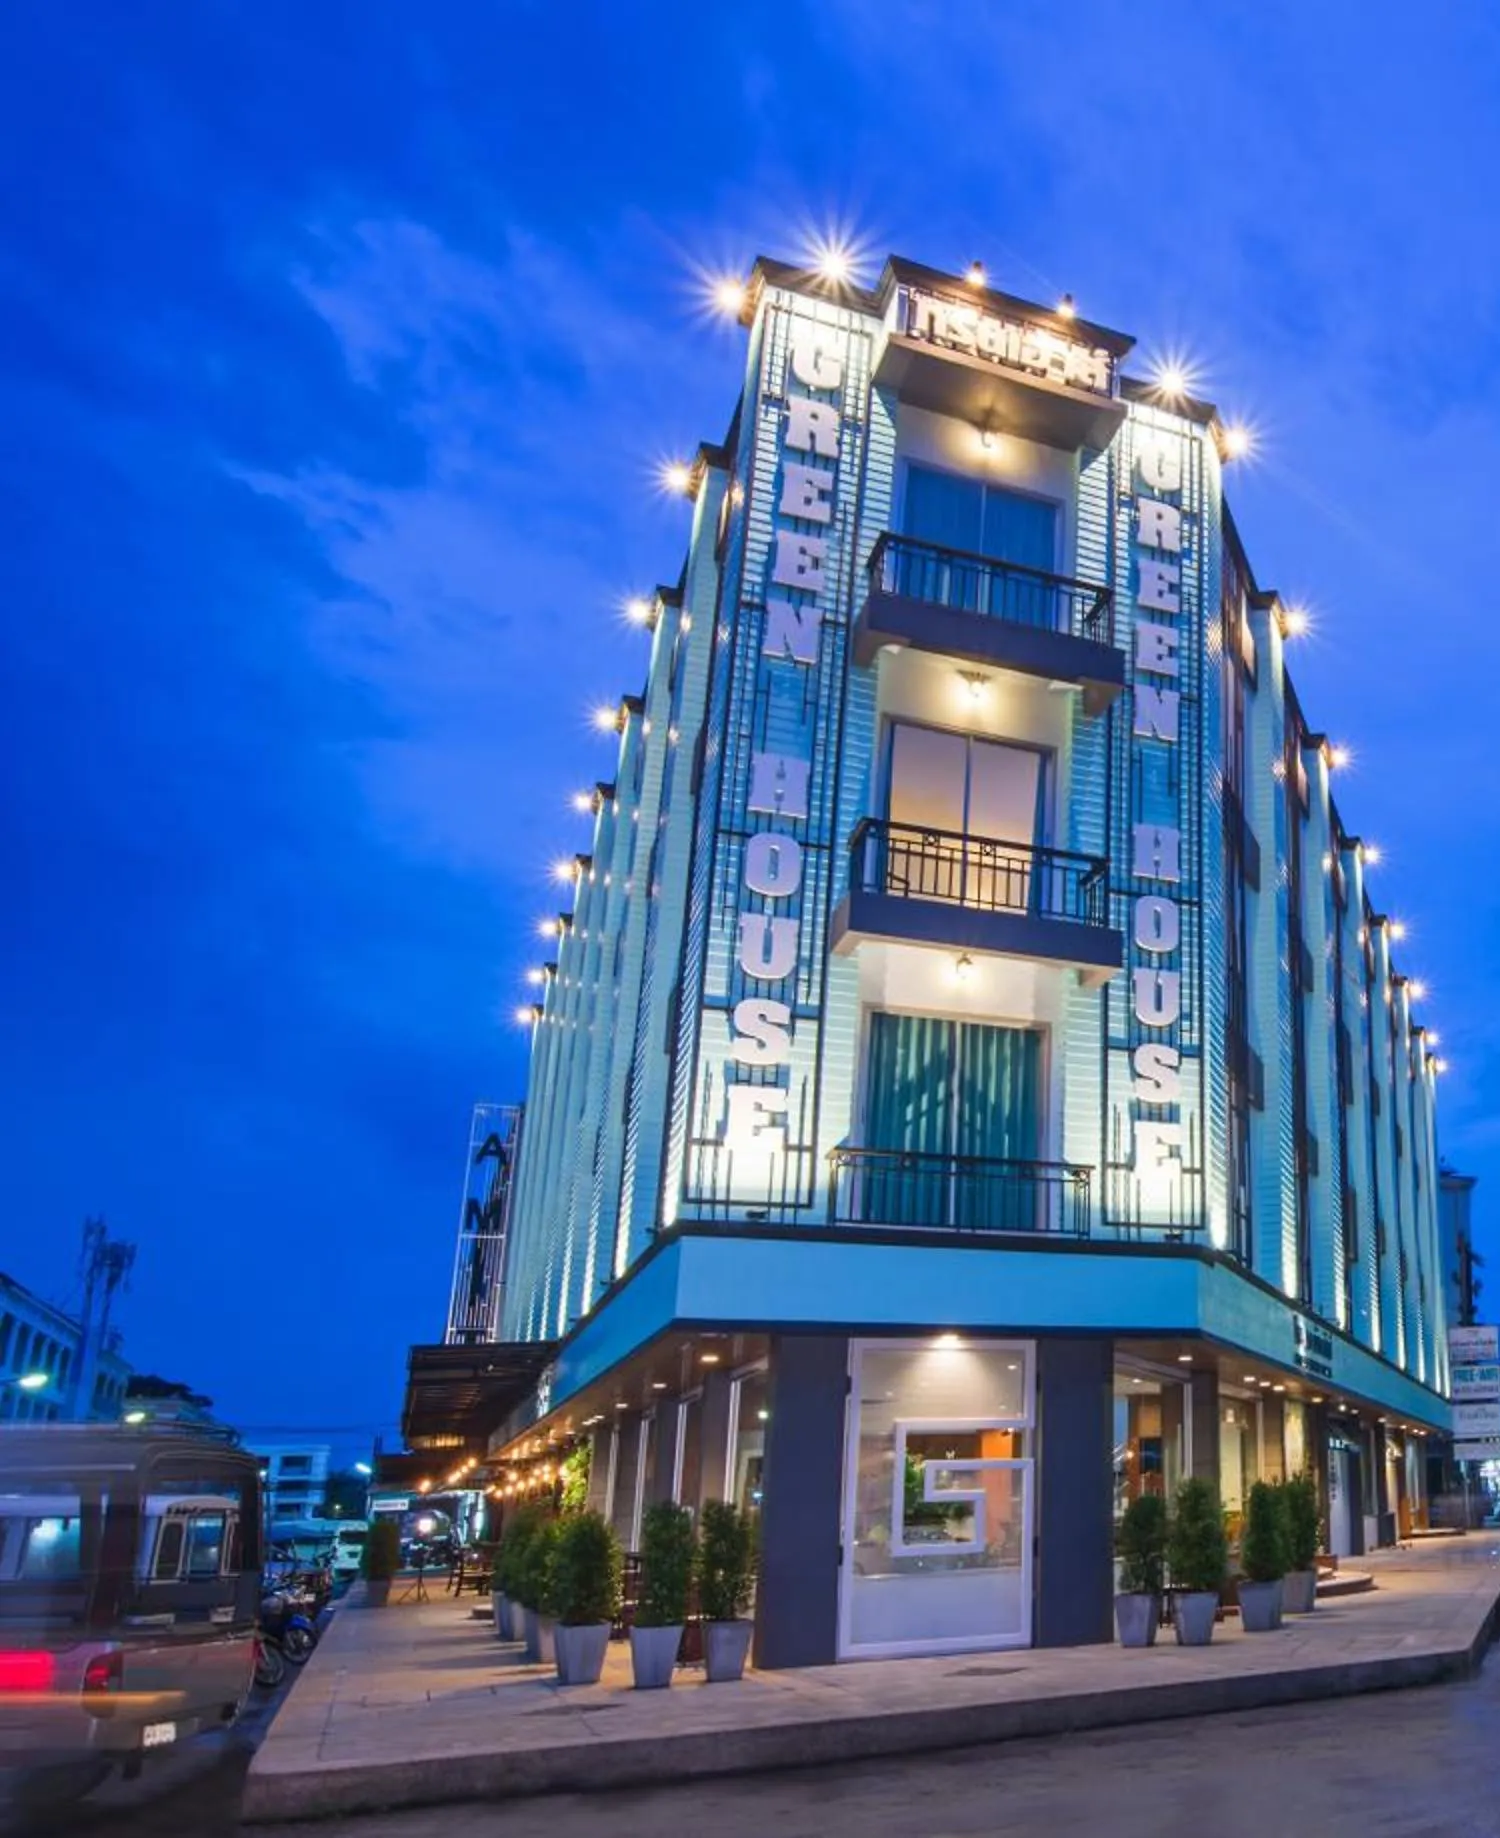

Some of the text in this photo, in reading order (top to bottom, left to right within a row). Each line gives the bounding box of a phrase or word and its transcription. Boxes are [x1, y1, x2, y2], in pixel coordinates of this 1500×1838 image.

[725, 333, 842, 1152] GREEN HOUSE
[1131, 436, 1182, 1184] GREEN HOUSE
